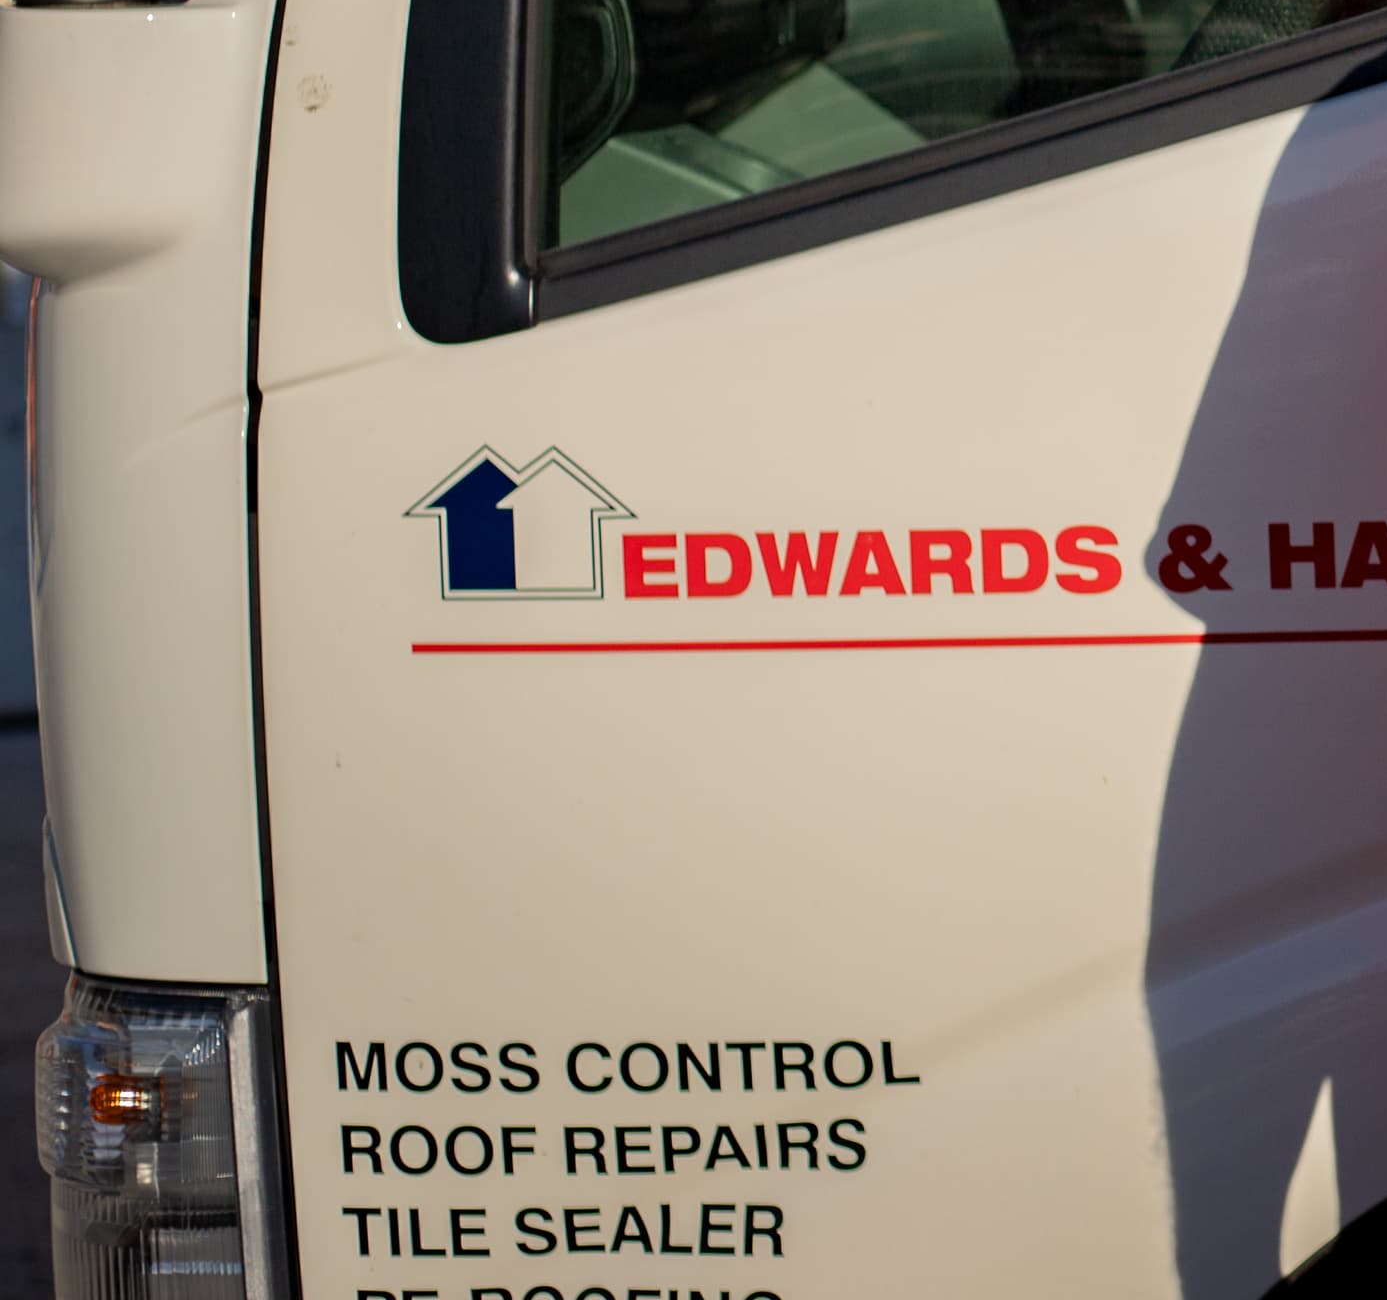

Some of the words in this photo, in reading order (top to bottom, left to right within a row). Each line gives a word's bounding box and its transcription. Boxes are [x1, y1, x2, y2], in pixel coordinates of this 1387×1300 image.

[620, 524, 1124, 601] EDWARDS
[1157, 522, 1233, 593] &
[335, 1041, 540, 1093] MOSS
[566, 1040, 921, 1093] CONTROL
[340, 1125, 537, 1175] ROOF
[563, 1118, 868, 1175] REPAIRS
[341, 1207, 491, 1257] TILE
[514, 1203, 785, 1257] SEALER
